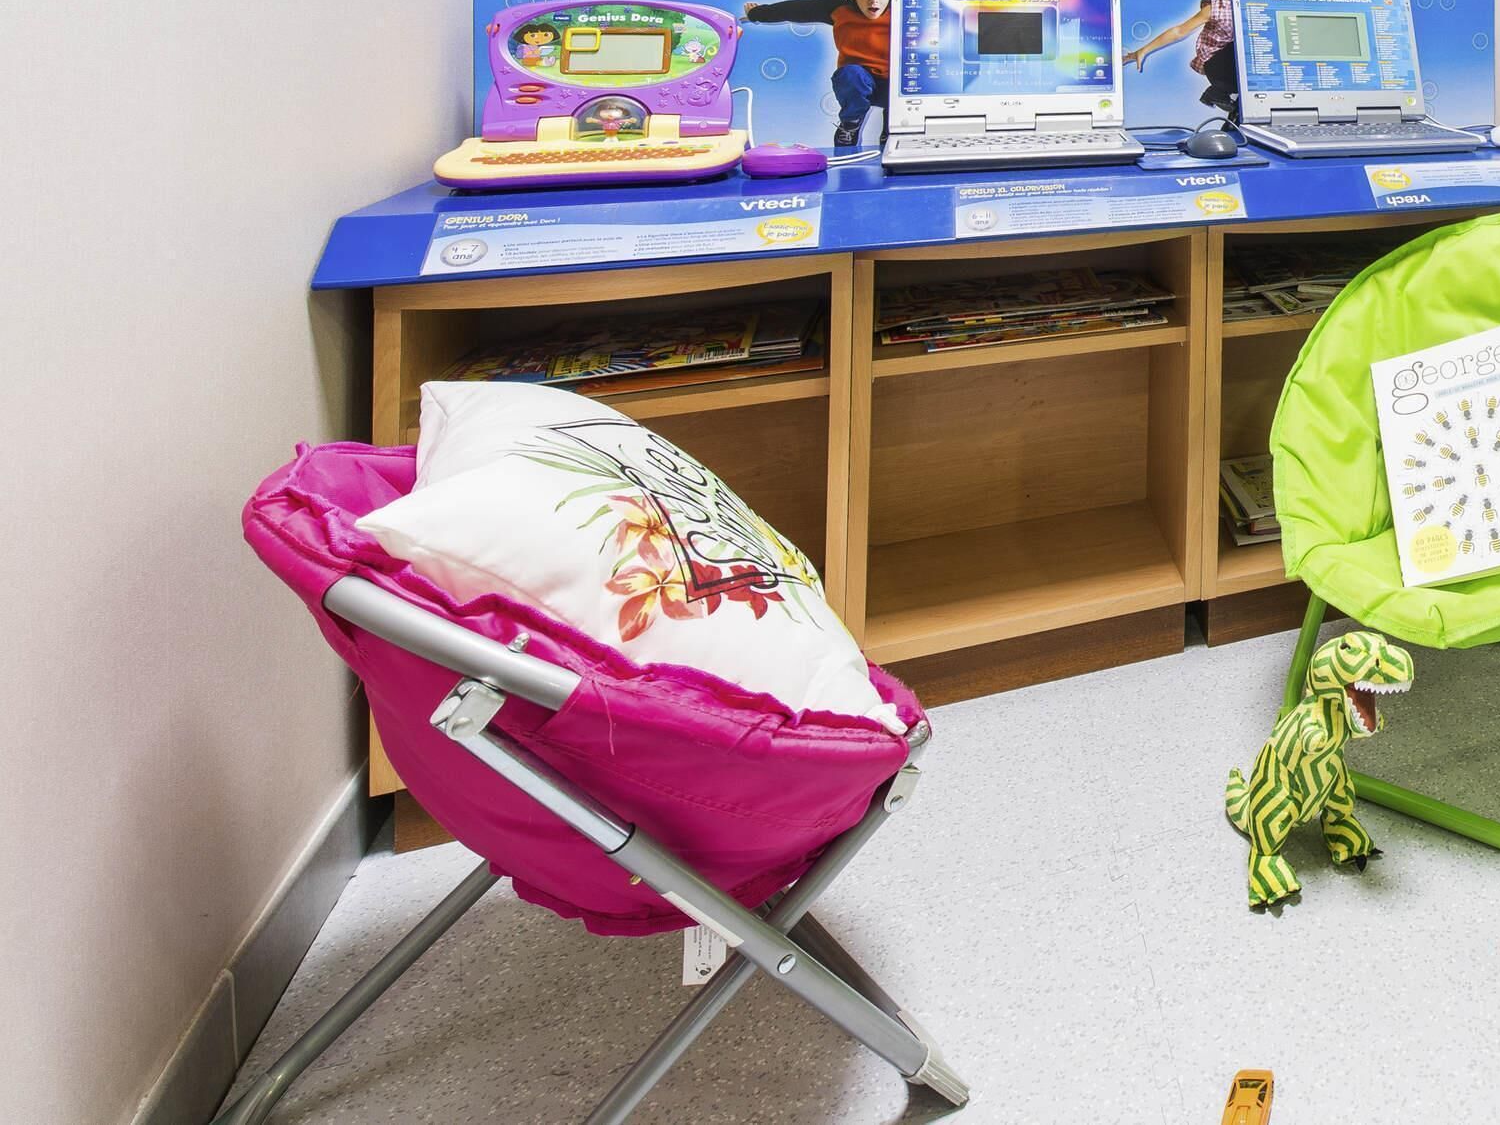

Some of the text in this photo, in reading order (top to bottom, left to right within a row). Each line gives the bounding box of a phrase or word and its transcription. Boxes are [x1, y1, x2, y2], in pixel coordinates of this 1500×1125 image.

[577, 12, 664, 24] Genius Dora
[1175, 174, 1227, 186] vtech
[738, 195, 807, 212] vtech
[1386, 194, 1431, 206] vtech
[445, 213, 529, 225] GENIUS DORA
